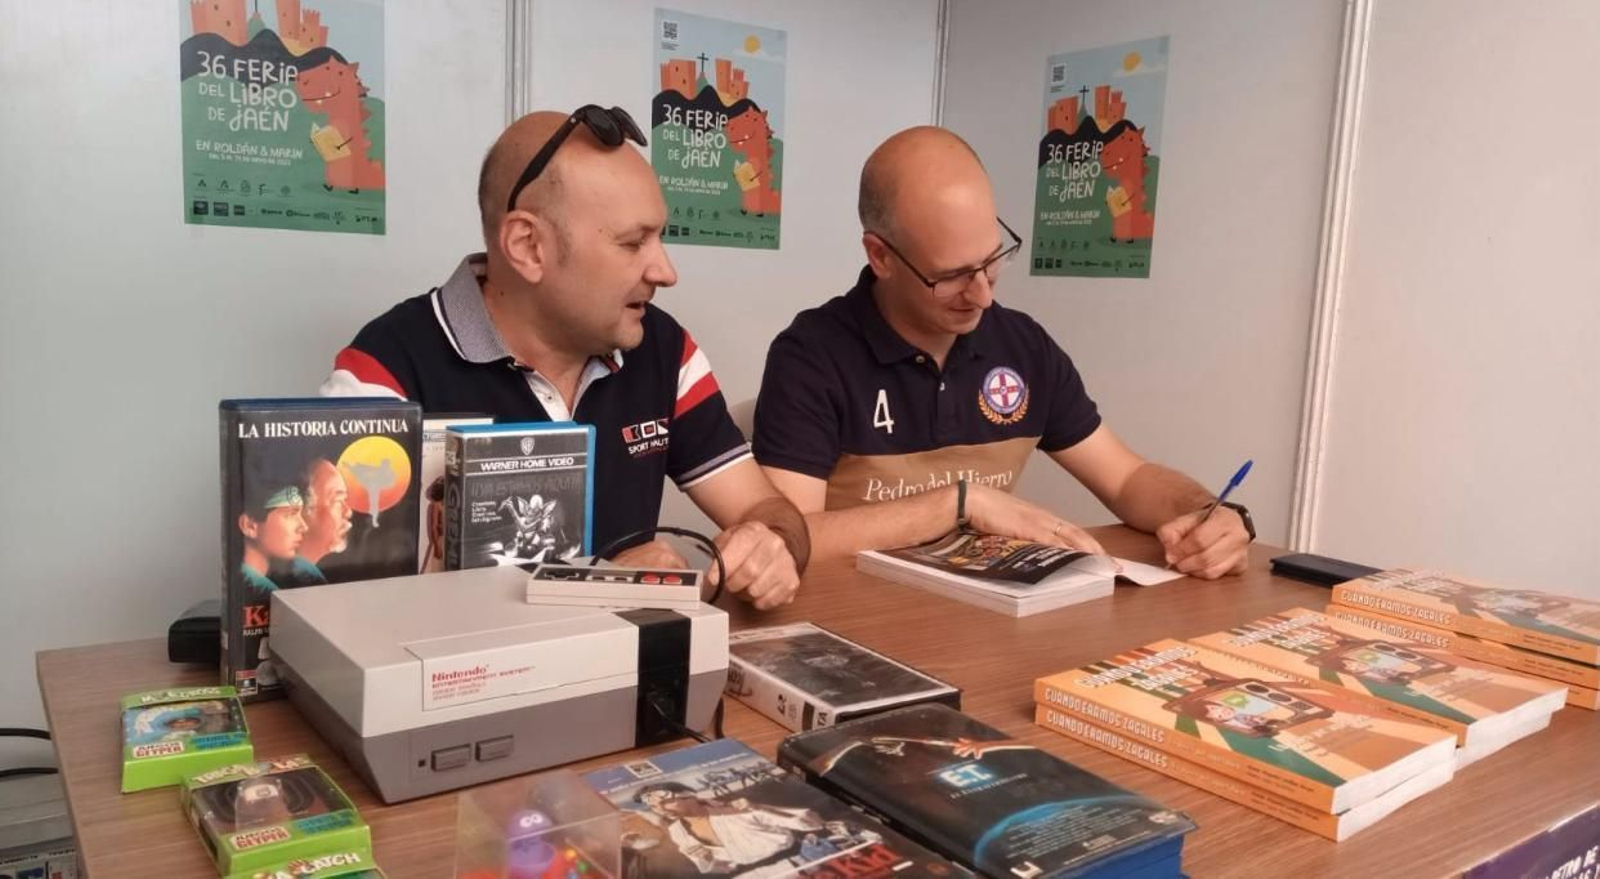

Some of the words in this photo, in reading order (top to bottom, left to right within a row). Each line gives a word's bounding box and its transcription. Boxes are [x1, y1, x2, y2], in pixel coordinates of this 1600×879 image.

[197, 51, 227, 79] 36
[199, 83, 225, 98] DEL
[208, 107, 225, 122] DE
[662, 104, 682, 125] 36
[662, 130, 680, 142] DEL
[195, 140, 211, 151] EN
[1046, 143, 1063, 164] 36
[668, 149, 680, 161] DE
[1046, 167, 1060, 179] DEL
[1049, 185, 1059, 197] DE
[873, 388, 895, 434] 4
[238, 422, 260, 439] LA
[264, 420, 337, 438] HISTORIA
[339, 418, 409, 435] CONTINUA
[480, 461, 519, 472] WARNER
[520, 459, 547, 469] HOME
[547, 457, 575, 467] VIDEO
[432, 666, 487, 683] Nintendo
[1045, 688, 1081, 714] CUANDO
[1122, 717, 1165, 743] ZAGALES
[1046, 710, 1083, 735] CUANDO
[1124, 741, 1168, 768] ZAGALES
